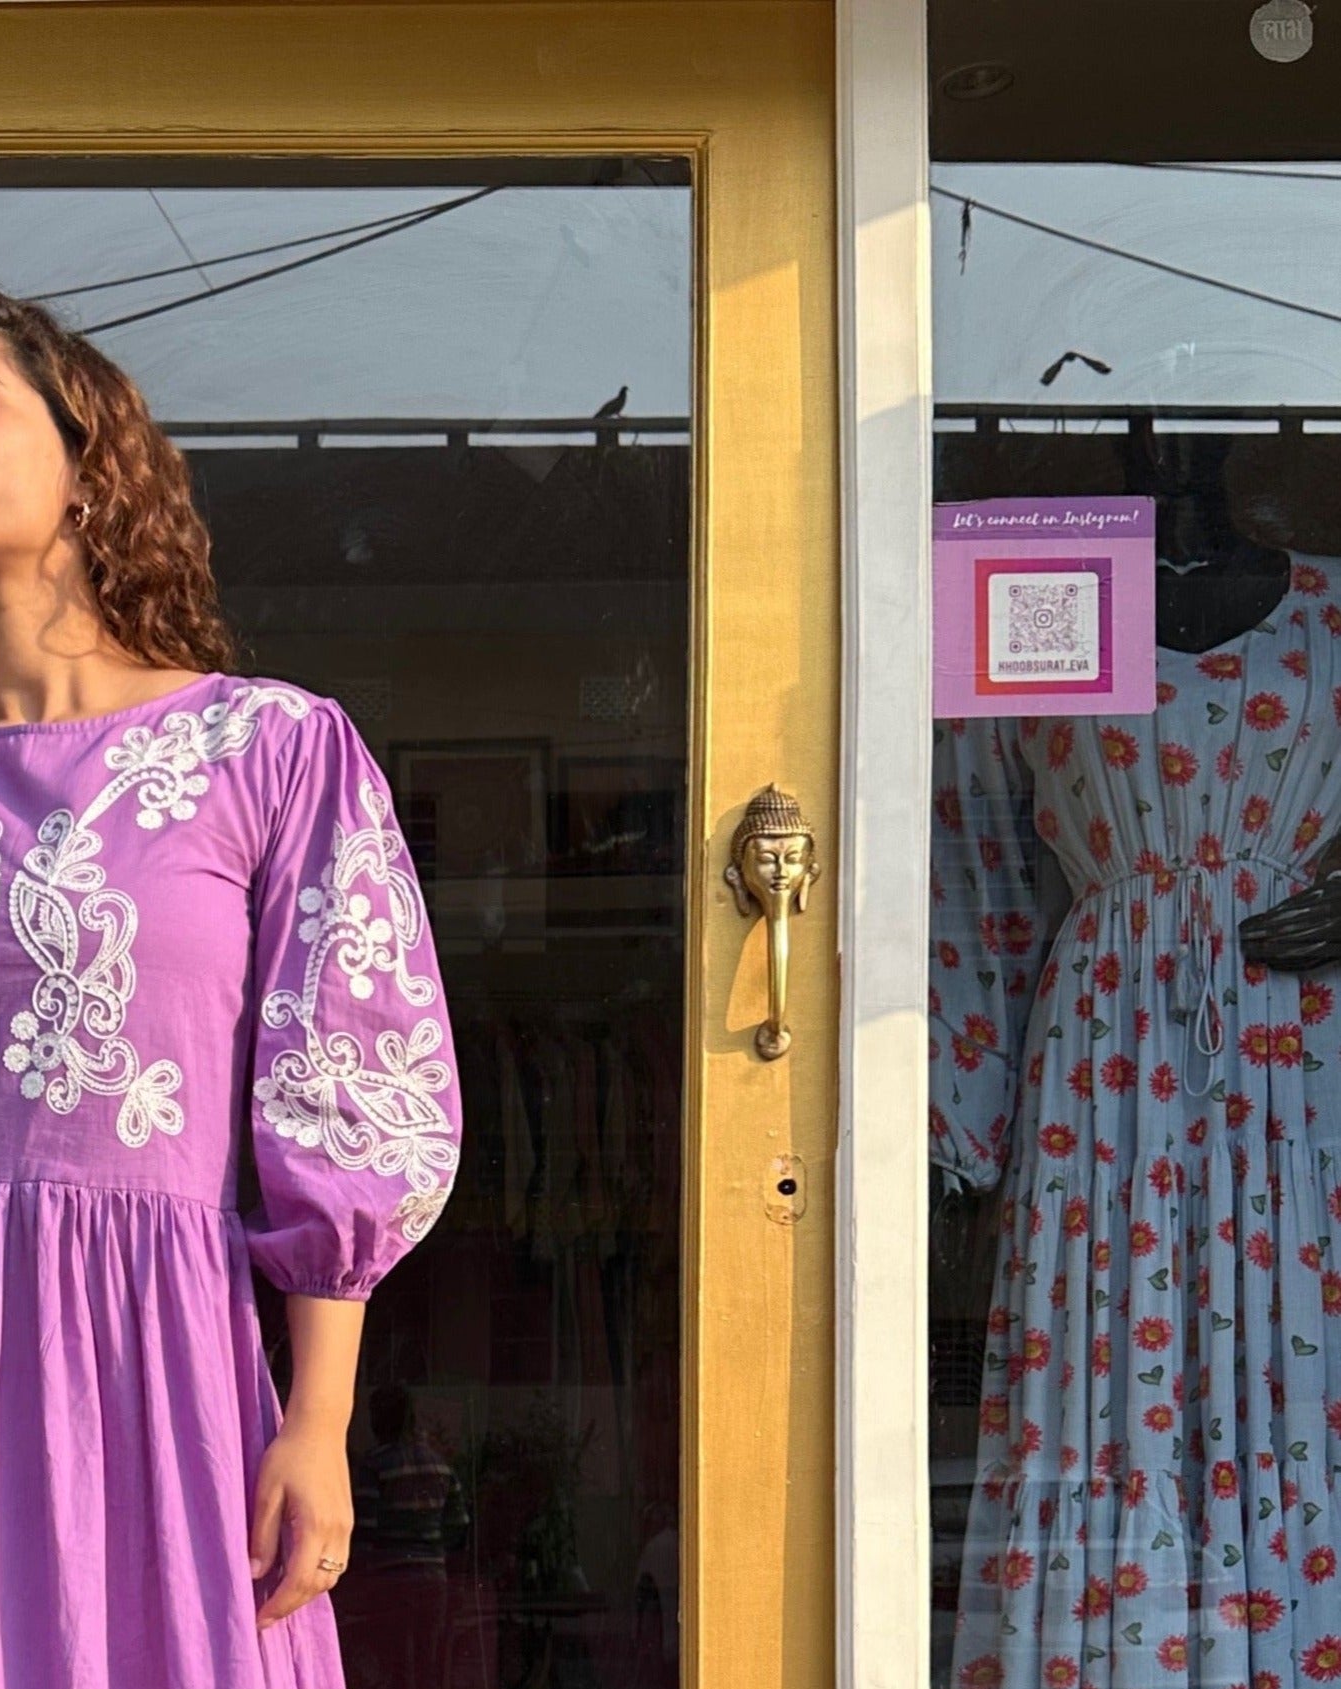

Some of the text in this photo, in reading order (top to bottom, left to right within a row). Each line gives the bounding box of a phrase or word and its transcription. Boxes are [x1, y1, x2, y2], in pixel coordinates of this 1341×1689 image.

[1259, 19, 1304, 42] लाभ
[953, 510, 1140, 530] Let's connect on Instagram!
